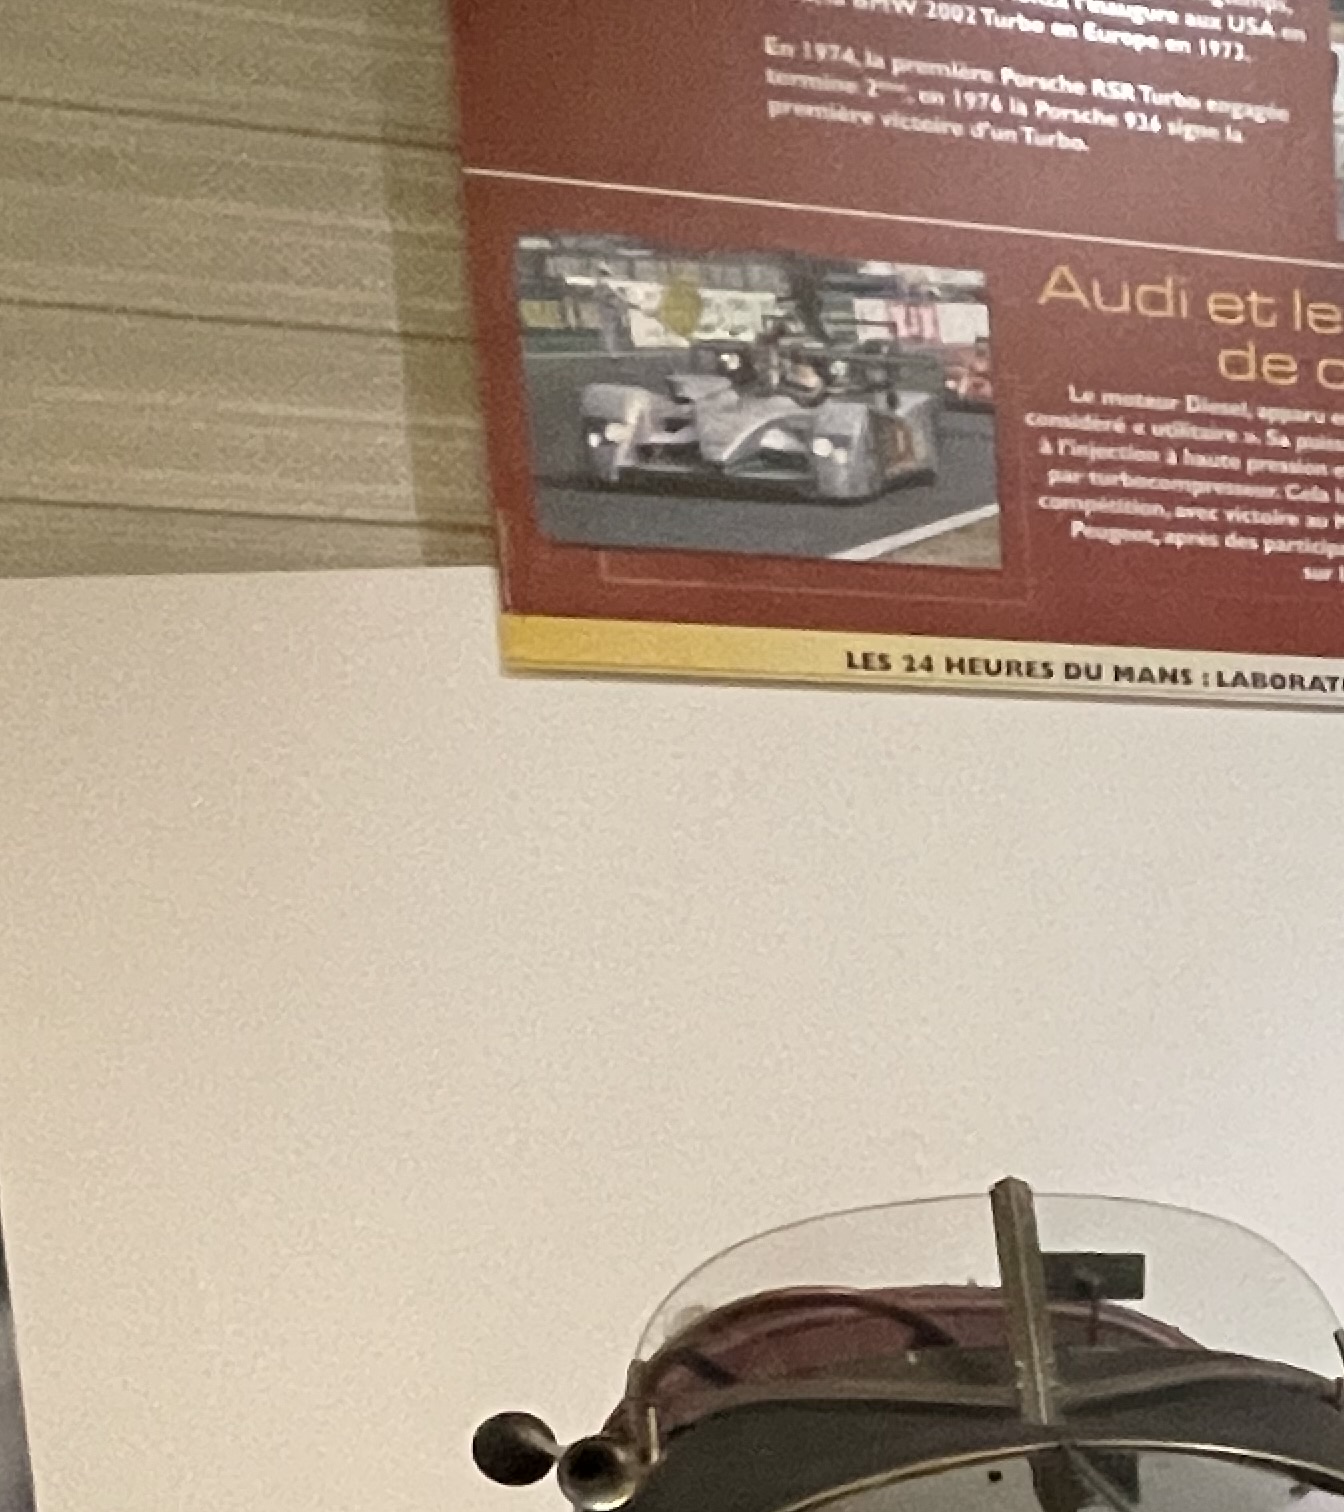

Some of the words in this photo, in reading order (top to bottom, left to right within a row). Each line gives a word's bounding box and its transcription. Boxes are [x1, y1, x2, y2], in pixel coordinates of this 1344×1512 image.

[925, 1, 977, 26] 2002
[979, 6, 1045, 33] Turbo
[1082, 21, 1160, 54] Europe
[1165, 38, 1192, 54] en
[1227, 14, 1276, 38] USA
[1000, 66, 1087, 96] Porsche
[1091, 77, 1136, 102] RSR
[1137, 84, 1202, 110] Turbo
[1034, 98, 1119, 127] Porsche
[1036, 263, 1188, 320] Audi
[1206, 289, 1279, 329] et
[1292, 287, 1344, 335] le
[1217, 339, 1299, 387] de
[844, 650, 893, 673] LES
[900, 653, 935, 675] 24
[943, 655, 1055, 681] HEURES
[1063, 661, 1103, 682] DU
[1112, 664, 1194, 687] MANS
